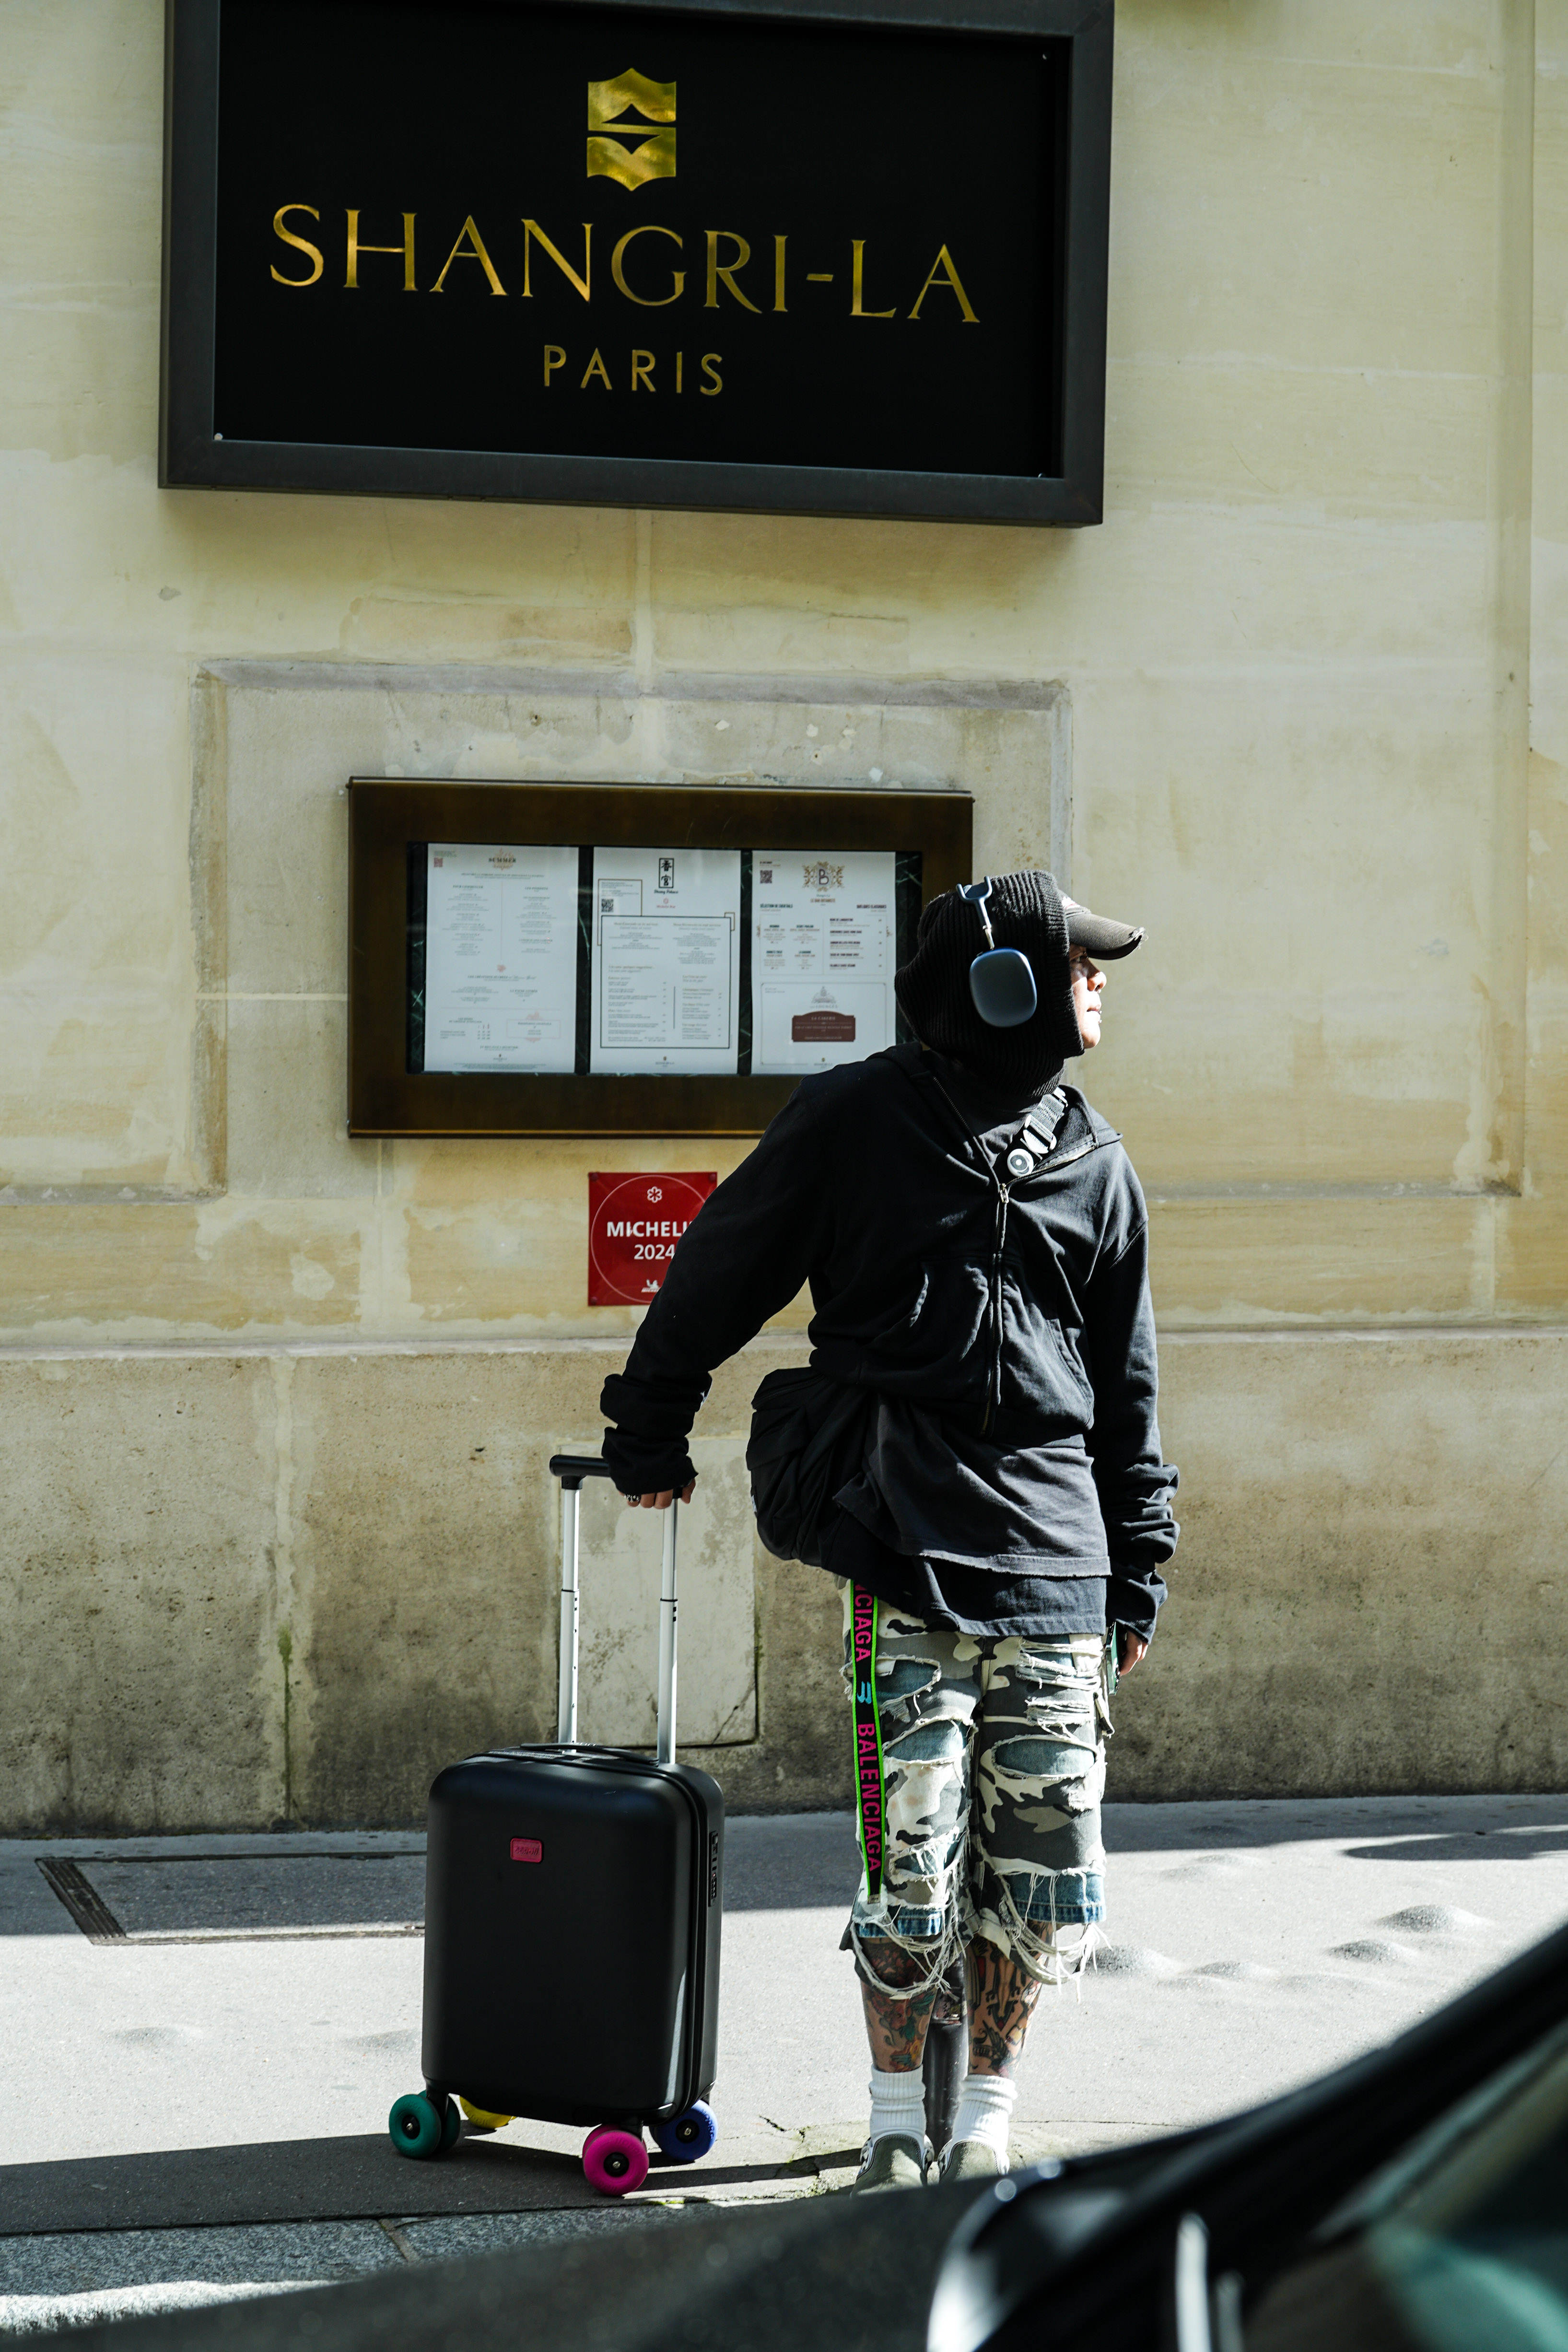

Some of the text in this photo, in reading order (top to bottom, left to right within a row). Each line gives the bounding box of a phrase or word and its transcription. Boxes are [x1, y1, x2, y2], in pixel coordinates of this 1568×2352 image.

[270, 203, 980, 323] SHANGRI-LA
[544, 345, 723, 396] PARIS
[607, 1221, 692, 1237] MICHELI
[634, 1244, 675, 1260] 2024
[858, 1723, 880, 1871] BALENCIAGA
